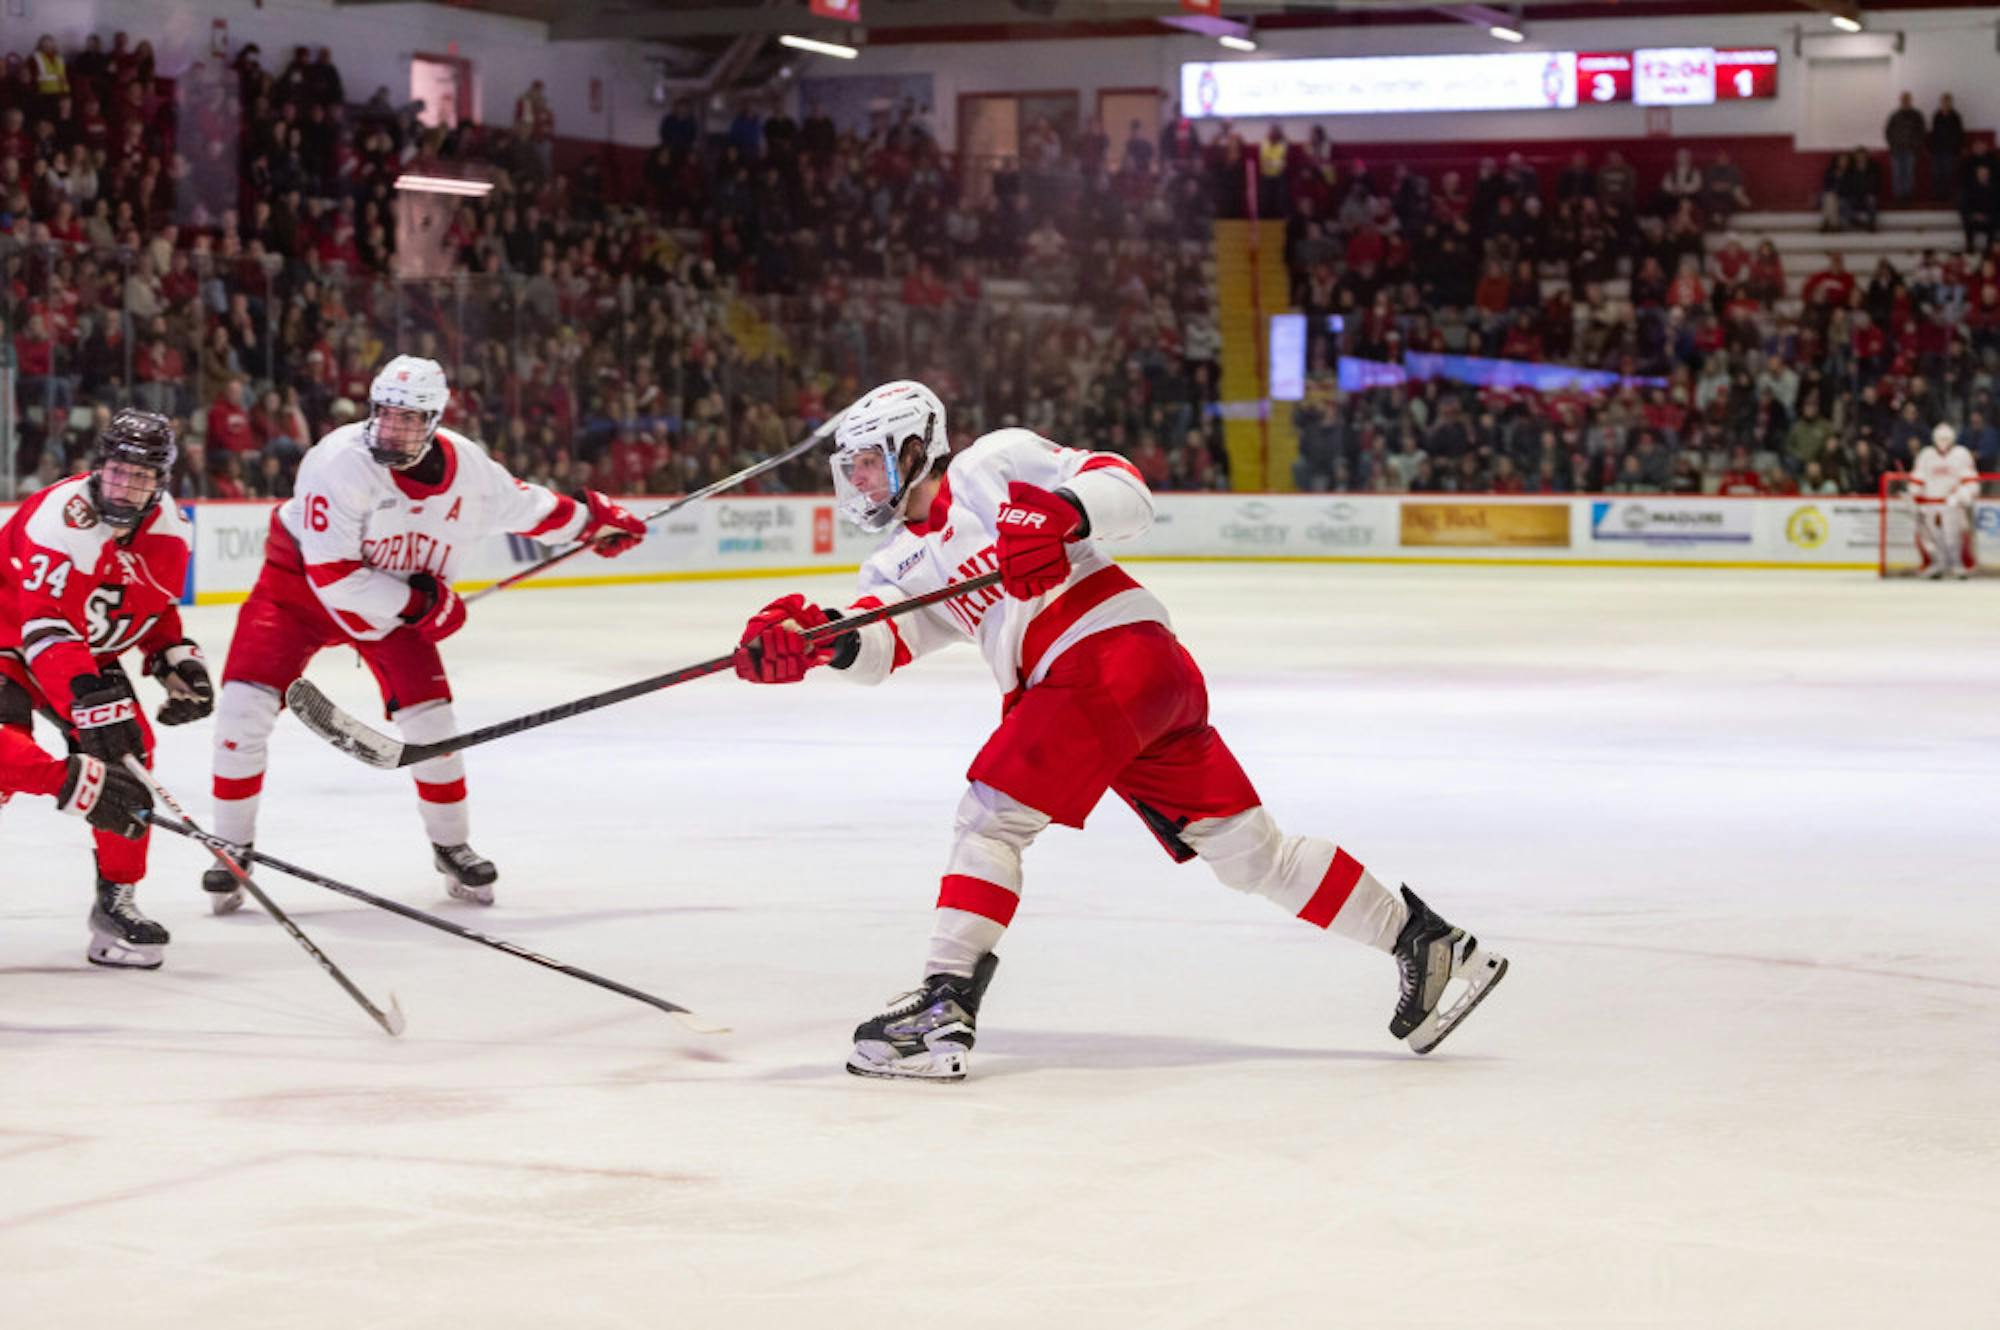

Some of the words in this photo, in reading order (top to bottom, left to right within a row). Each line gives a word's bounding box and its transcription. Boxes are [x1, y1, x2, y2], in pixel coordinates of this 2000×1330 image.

[1592, 73, 1616, 101] 3
[1733, 69, 1753, 97] 1
[304, 492, 329, 532] 16
[444, 496, 462, 521] A
[360, 531, 452, 580] CORNELL
[22, 554, 72, 598] 34
